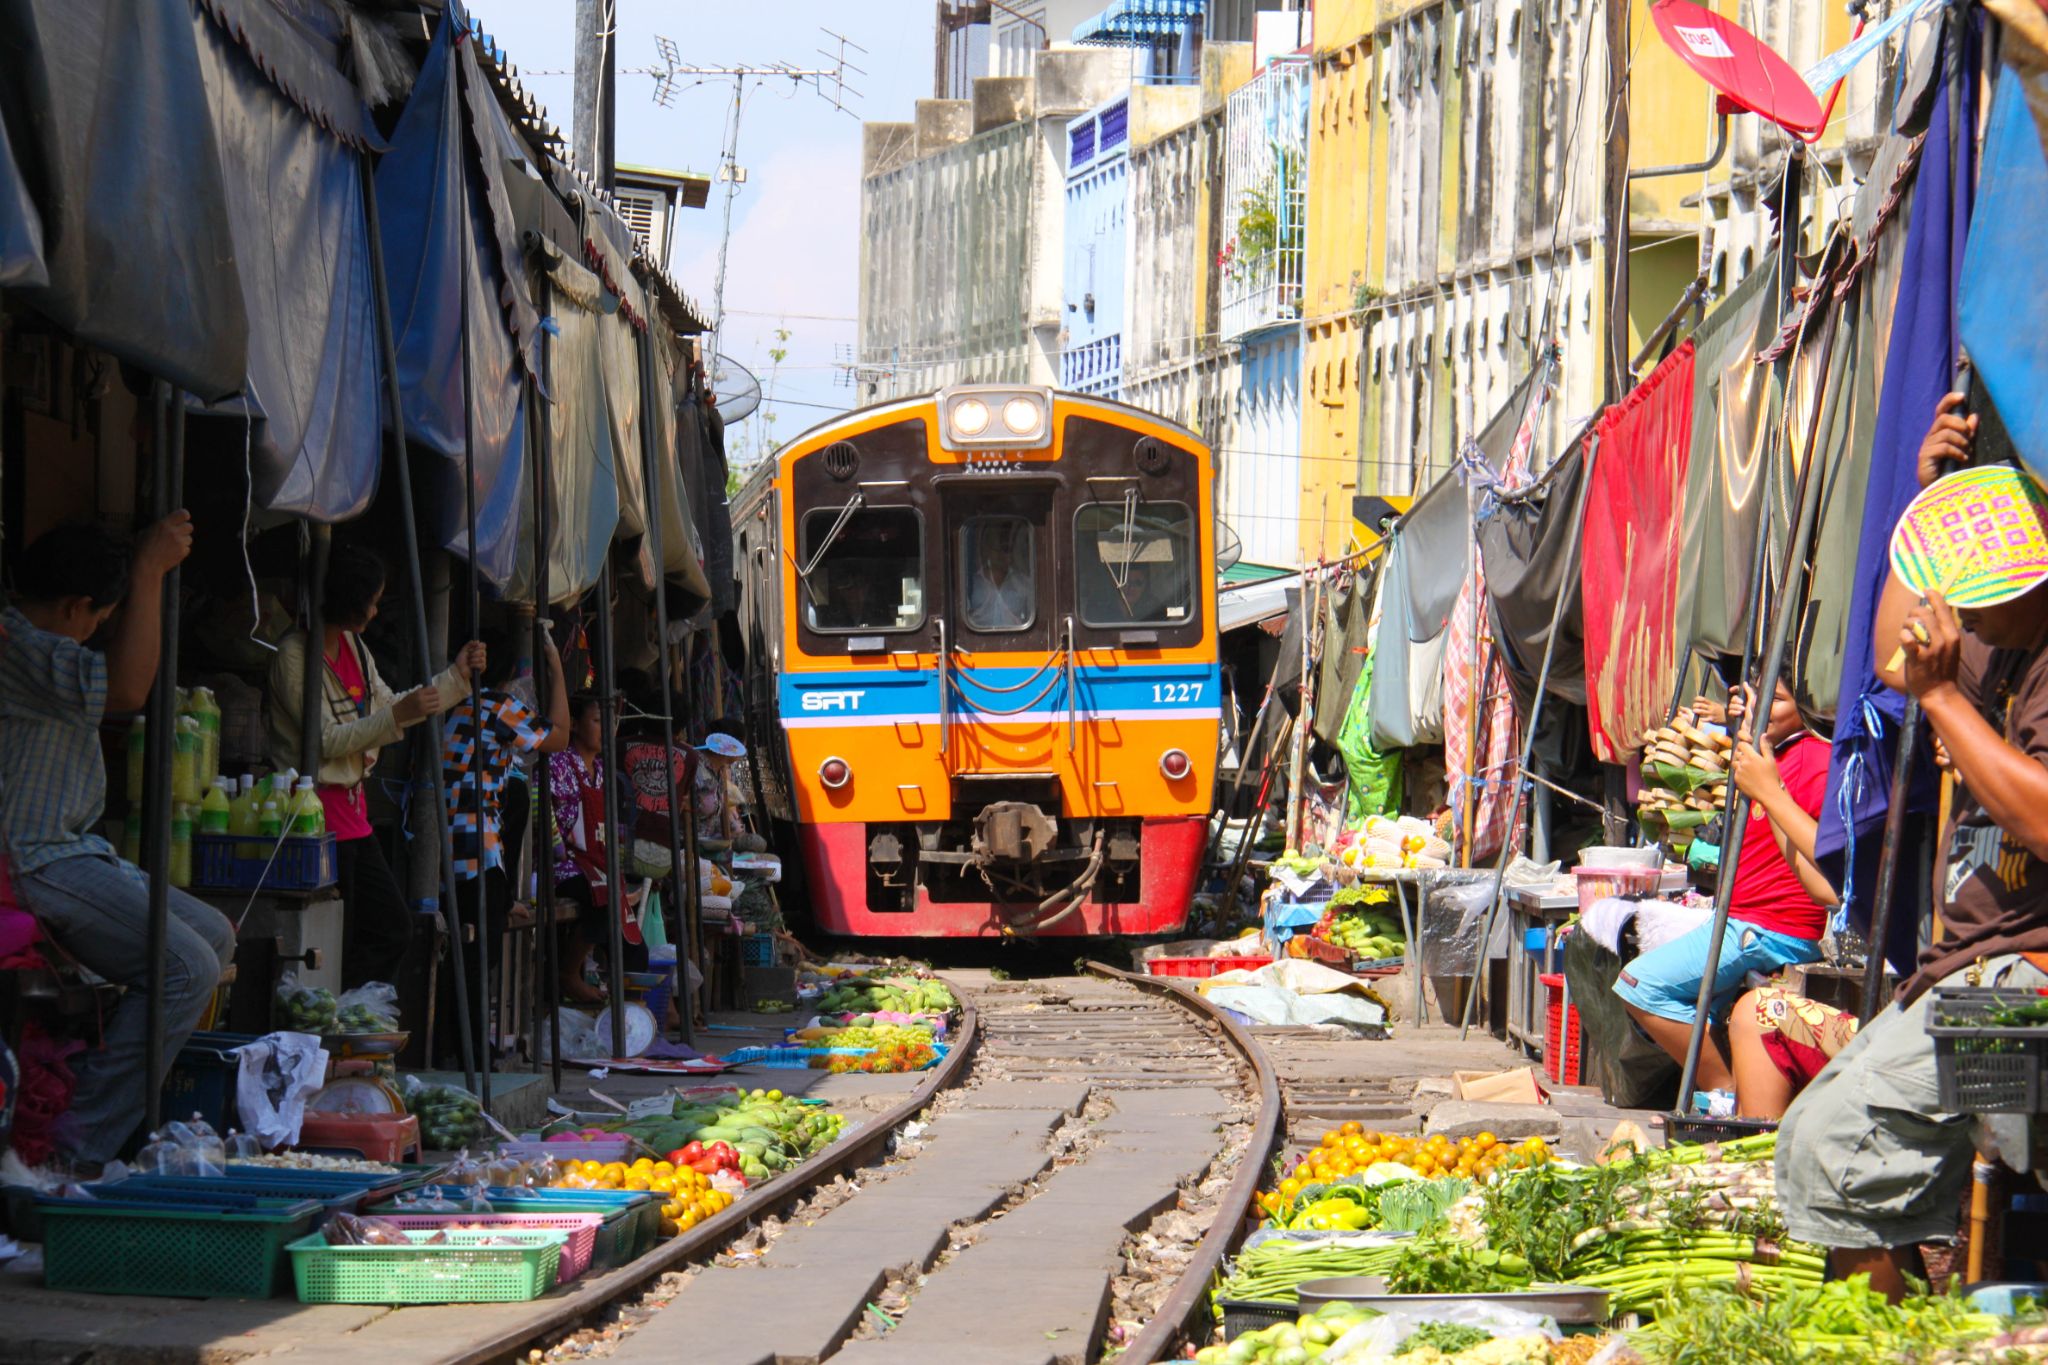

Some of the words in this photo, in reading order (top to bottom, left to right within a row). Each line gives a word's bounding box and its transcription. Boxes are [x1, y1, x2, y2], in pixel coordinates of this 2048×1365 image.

[1680, 29, 1712, 45] true
[801, 690, 866, 711] SRT
[1152, 682, 1203, 703] 1227
